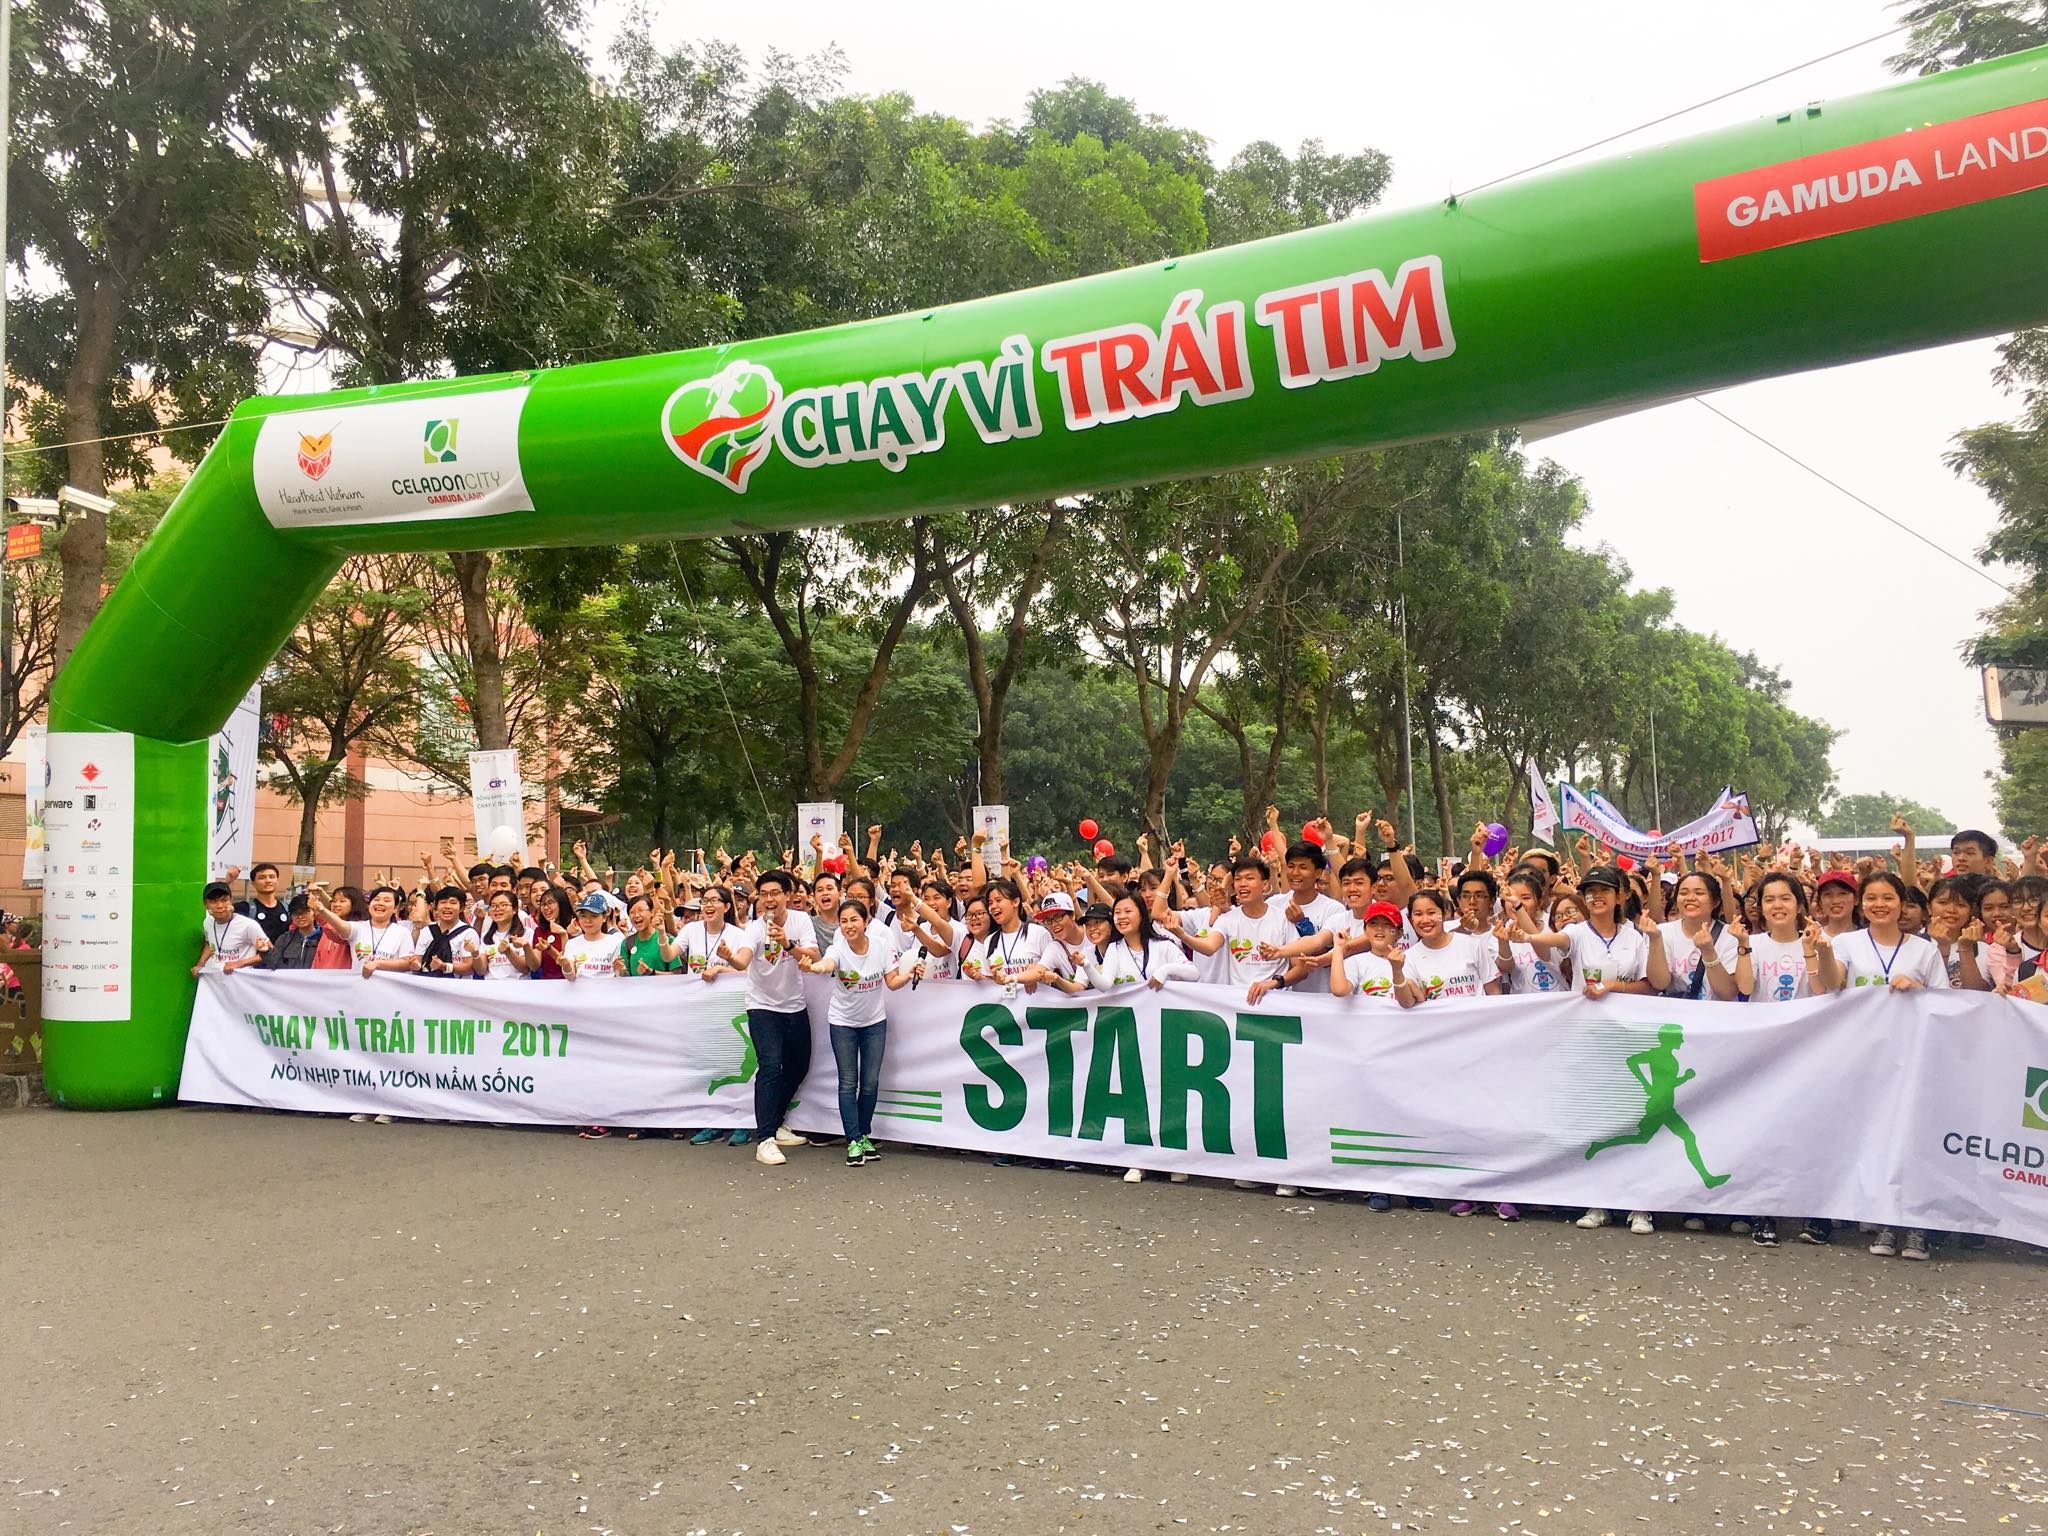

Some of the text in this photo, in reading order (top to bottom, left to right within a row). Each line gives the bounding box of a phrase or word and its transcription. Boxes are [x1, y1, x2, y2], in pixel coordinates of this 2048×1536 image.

[1727, 126, 2048, 227] GAMUDA LAND
[782, 266, 1443, 463] CHẠY VÌ TRÁI TIM
[325, 486, 365, 501] Vietnam
[427, 491, 485, 504] GAMUDA LAND
[1702, 826, 1735, 847] 2017
[324, 1010, 350, 1051] VÌ
[355, 1011, 415, 1054] TRÁI
[424, 1019, 492, 1055] TIM"
[502, 1020, 569, 1058] 2017
[303, 1066, 340, 1089] NHỊP
[343, 1069, 377, 1091] TIM,
[380, 1069, 431, 1089] VƯƠN
[436, 1066, 477, 1092] MẦM
[482, 1067, 534, 1094] SỐNG
[959, 1003, 1303, 1160] START
